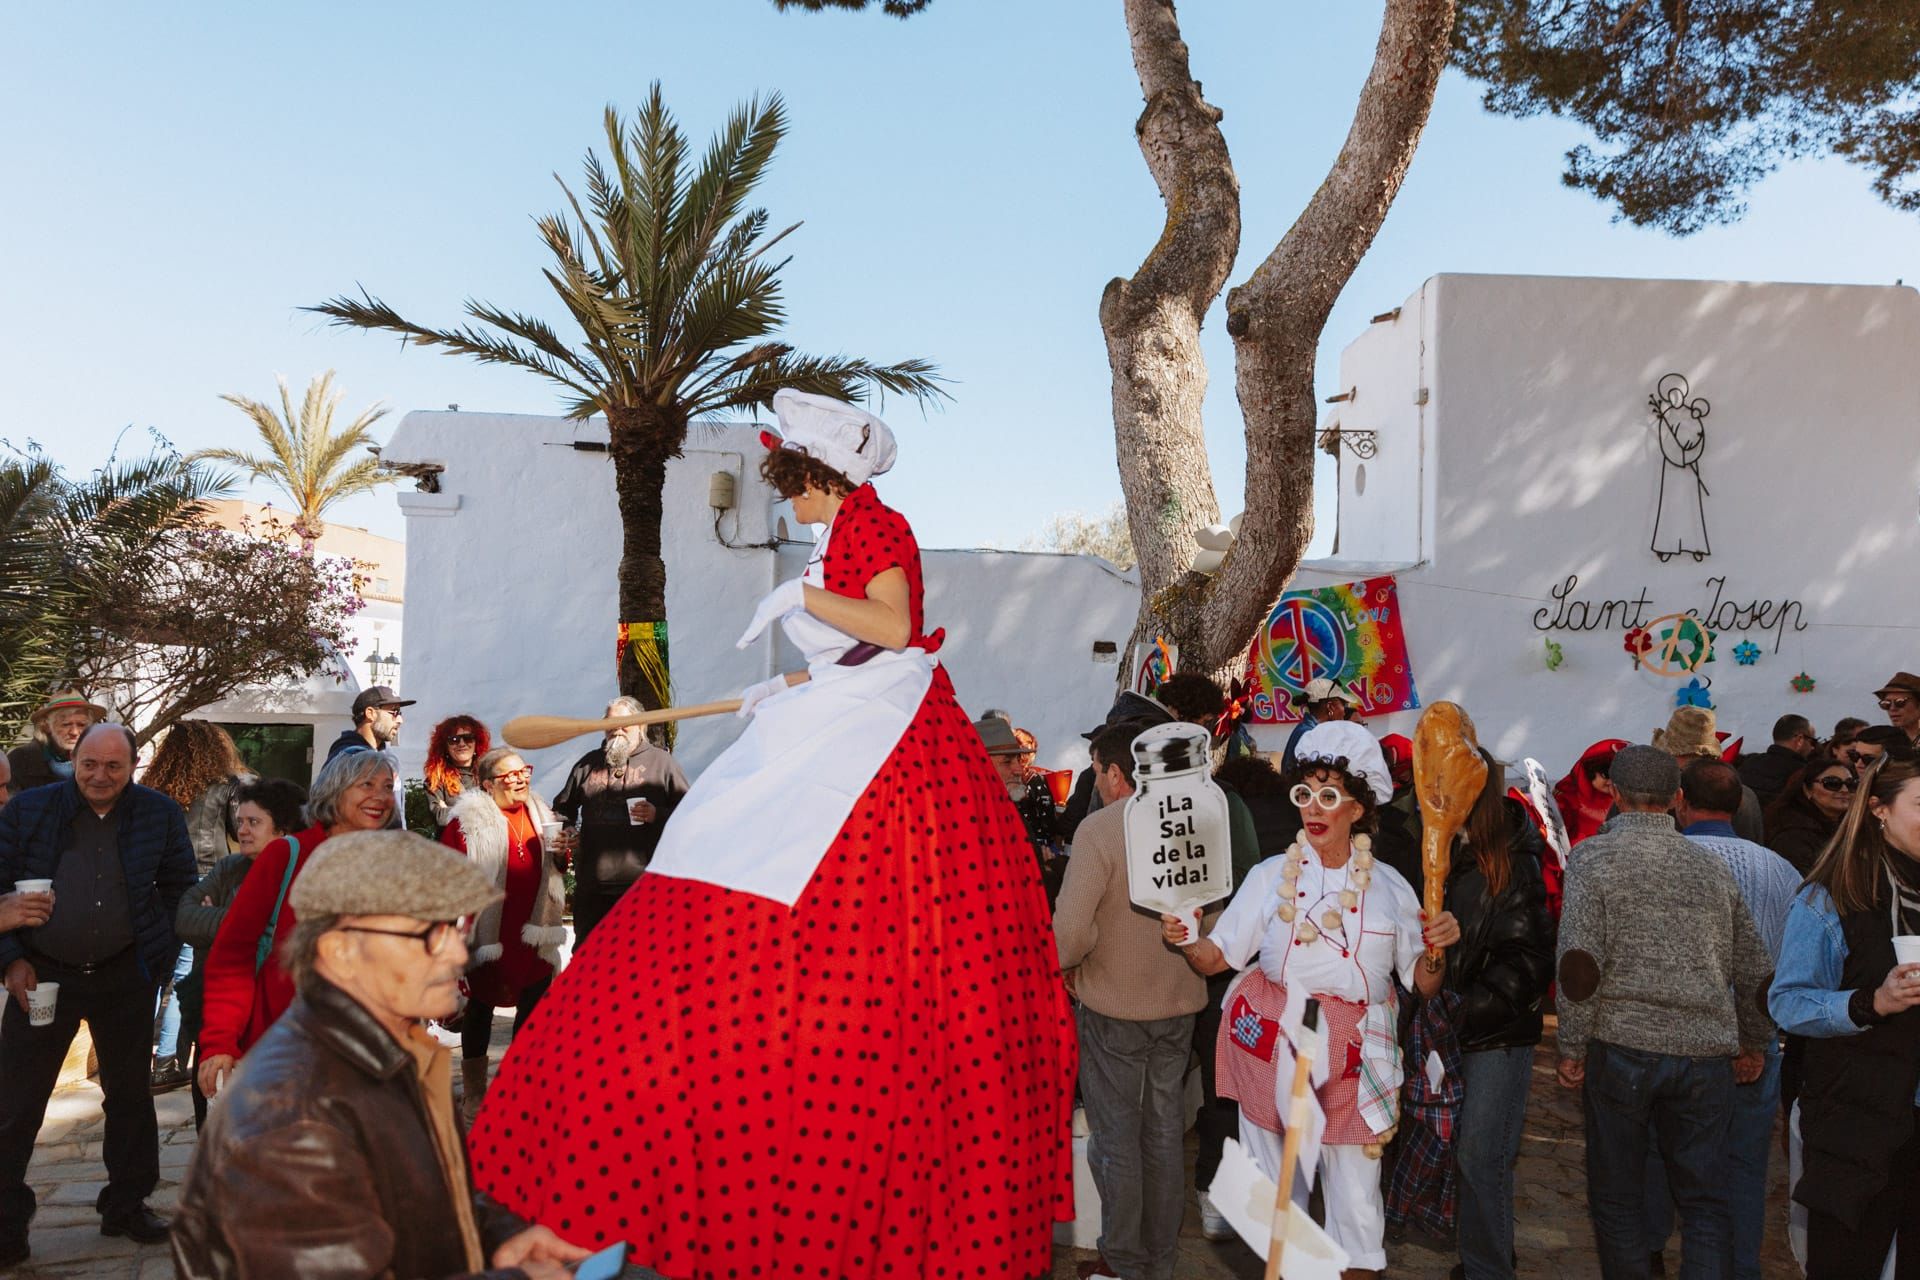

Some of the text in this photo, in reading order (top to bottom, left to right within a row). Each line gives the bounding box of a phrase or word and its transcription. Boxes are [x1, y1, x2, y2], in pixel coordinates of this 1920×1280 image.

[1533, 574, 1654, 631] Sant
[1158, 795, 1193, 819] ¡La
[1160, 816, 1195, 839] Sal
[1152, 841, 1206, 864] de la
[1152, 863, 1209, 889] vida!
